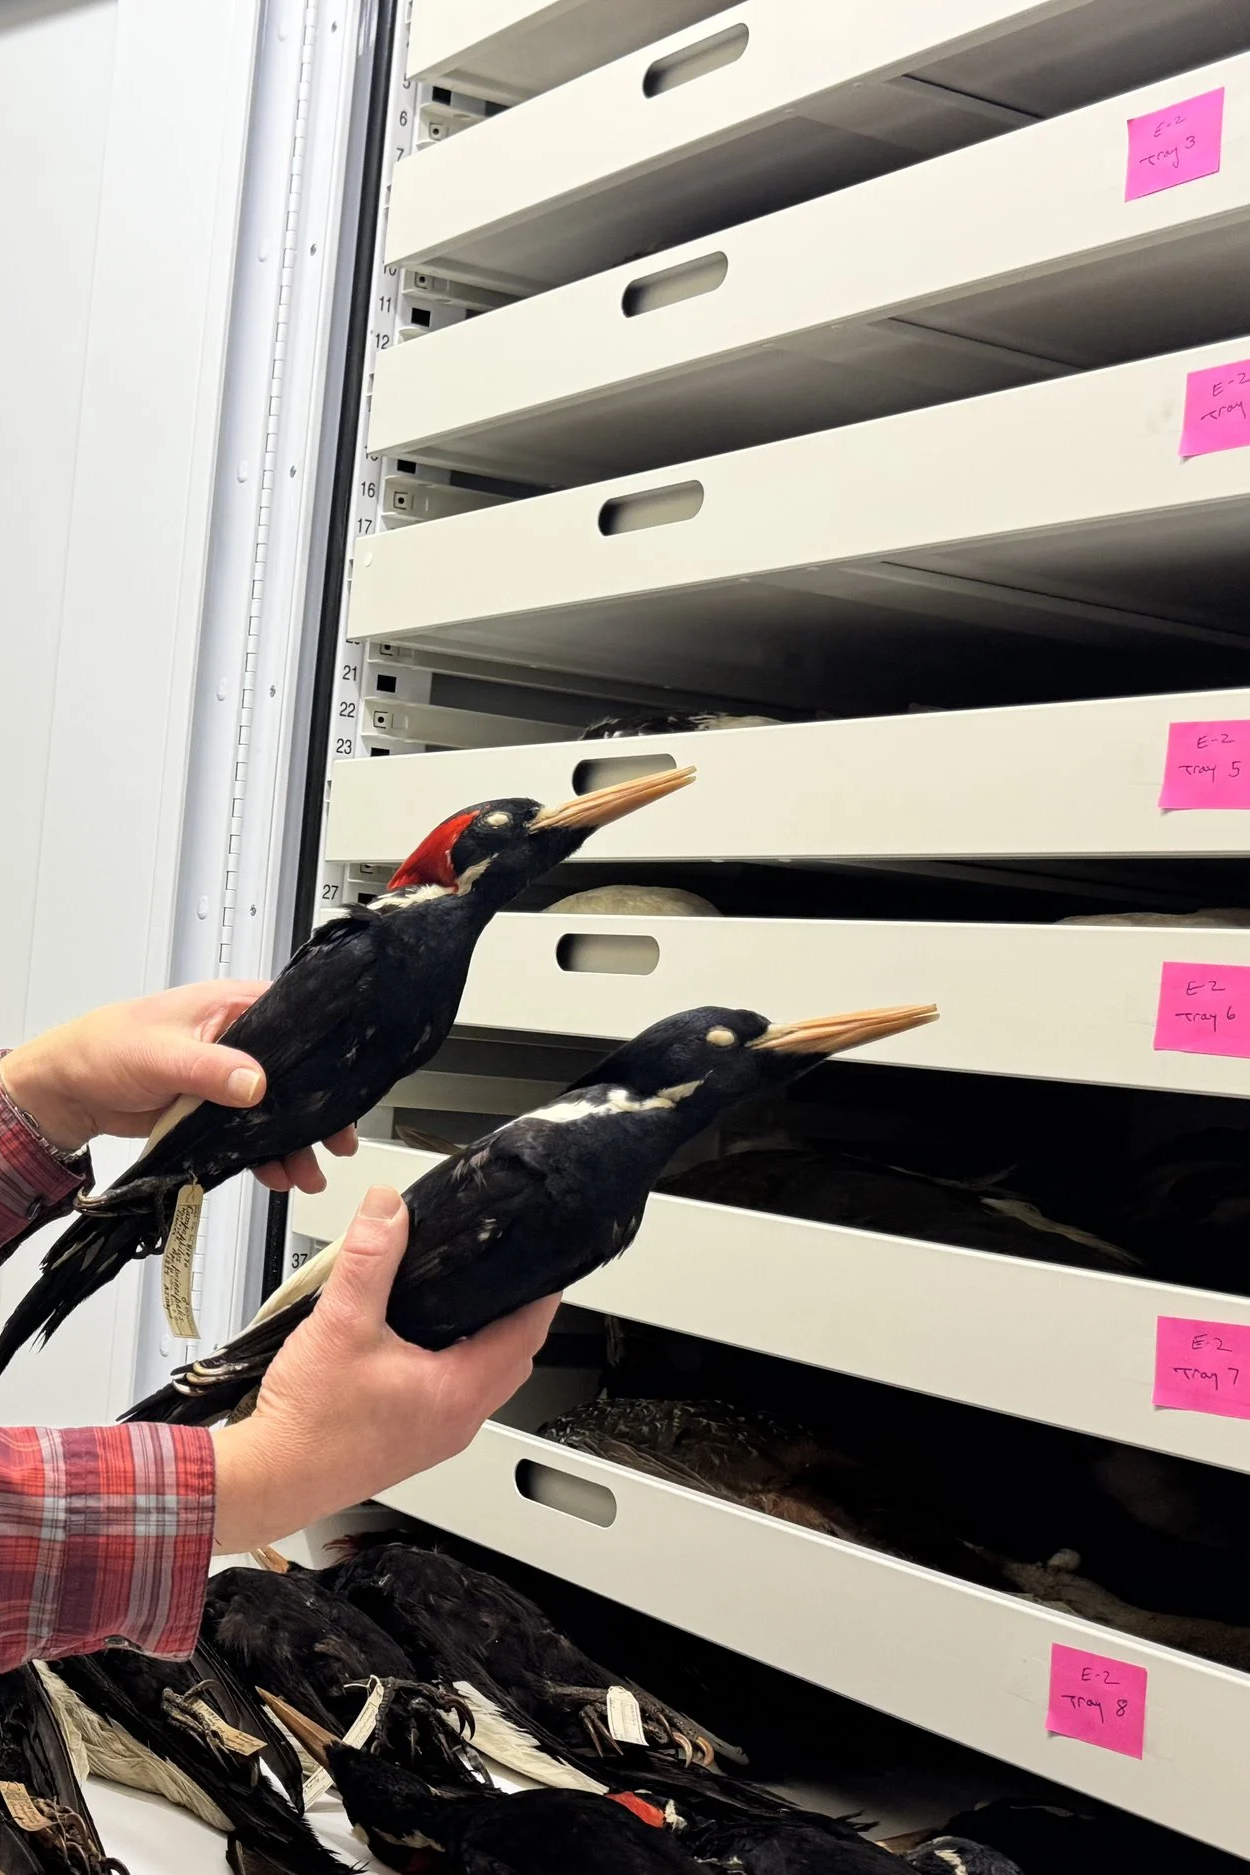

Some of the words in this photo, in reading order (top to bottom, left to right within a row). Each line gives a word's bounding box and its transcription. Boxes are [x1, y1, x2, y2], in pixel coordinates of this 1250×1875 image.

[399, 110, 408, 127] 6
[1185, 135, 1196, 149] 3
[396, 147, 405, 161] 7
[379, 296, 391, 313] 11
[376, 332, 390, 349] 12
[361, 481, 376, 498] 16
[358, 518, 372, 534] 17
[342, 664, 357, 681] 21
[339, 701, 356, 718] 22
[336, 738, 352, 755] 23
[1197, 733, 1236, 749] E-2
[1178, 764, 1217, 783] Tray
[1228, 760, 1241, 778] 5
[322, 884, 339, 900] 27
[1175, 1012, 1217, 1032] Tray
[1226, 1005, 1236, 1020] 6
[291, 1252, 308, 1269] 37
[1174, 1367, 1218, 1391] Tray
[1227, 1367, 1239, 1385] 7
[1081, 1667, 1121, 1685] E-2
[1061, 1694, 1104, 1723] Tray
[1116, 1699, 1128, 1717] 8
